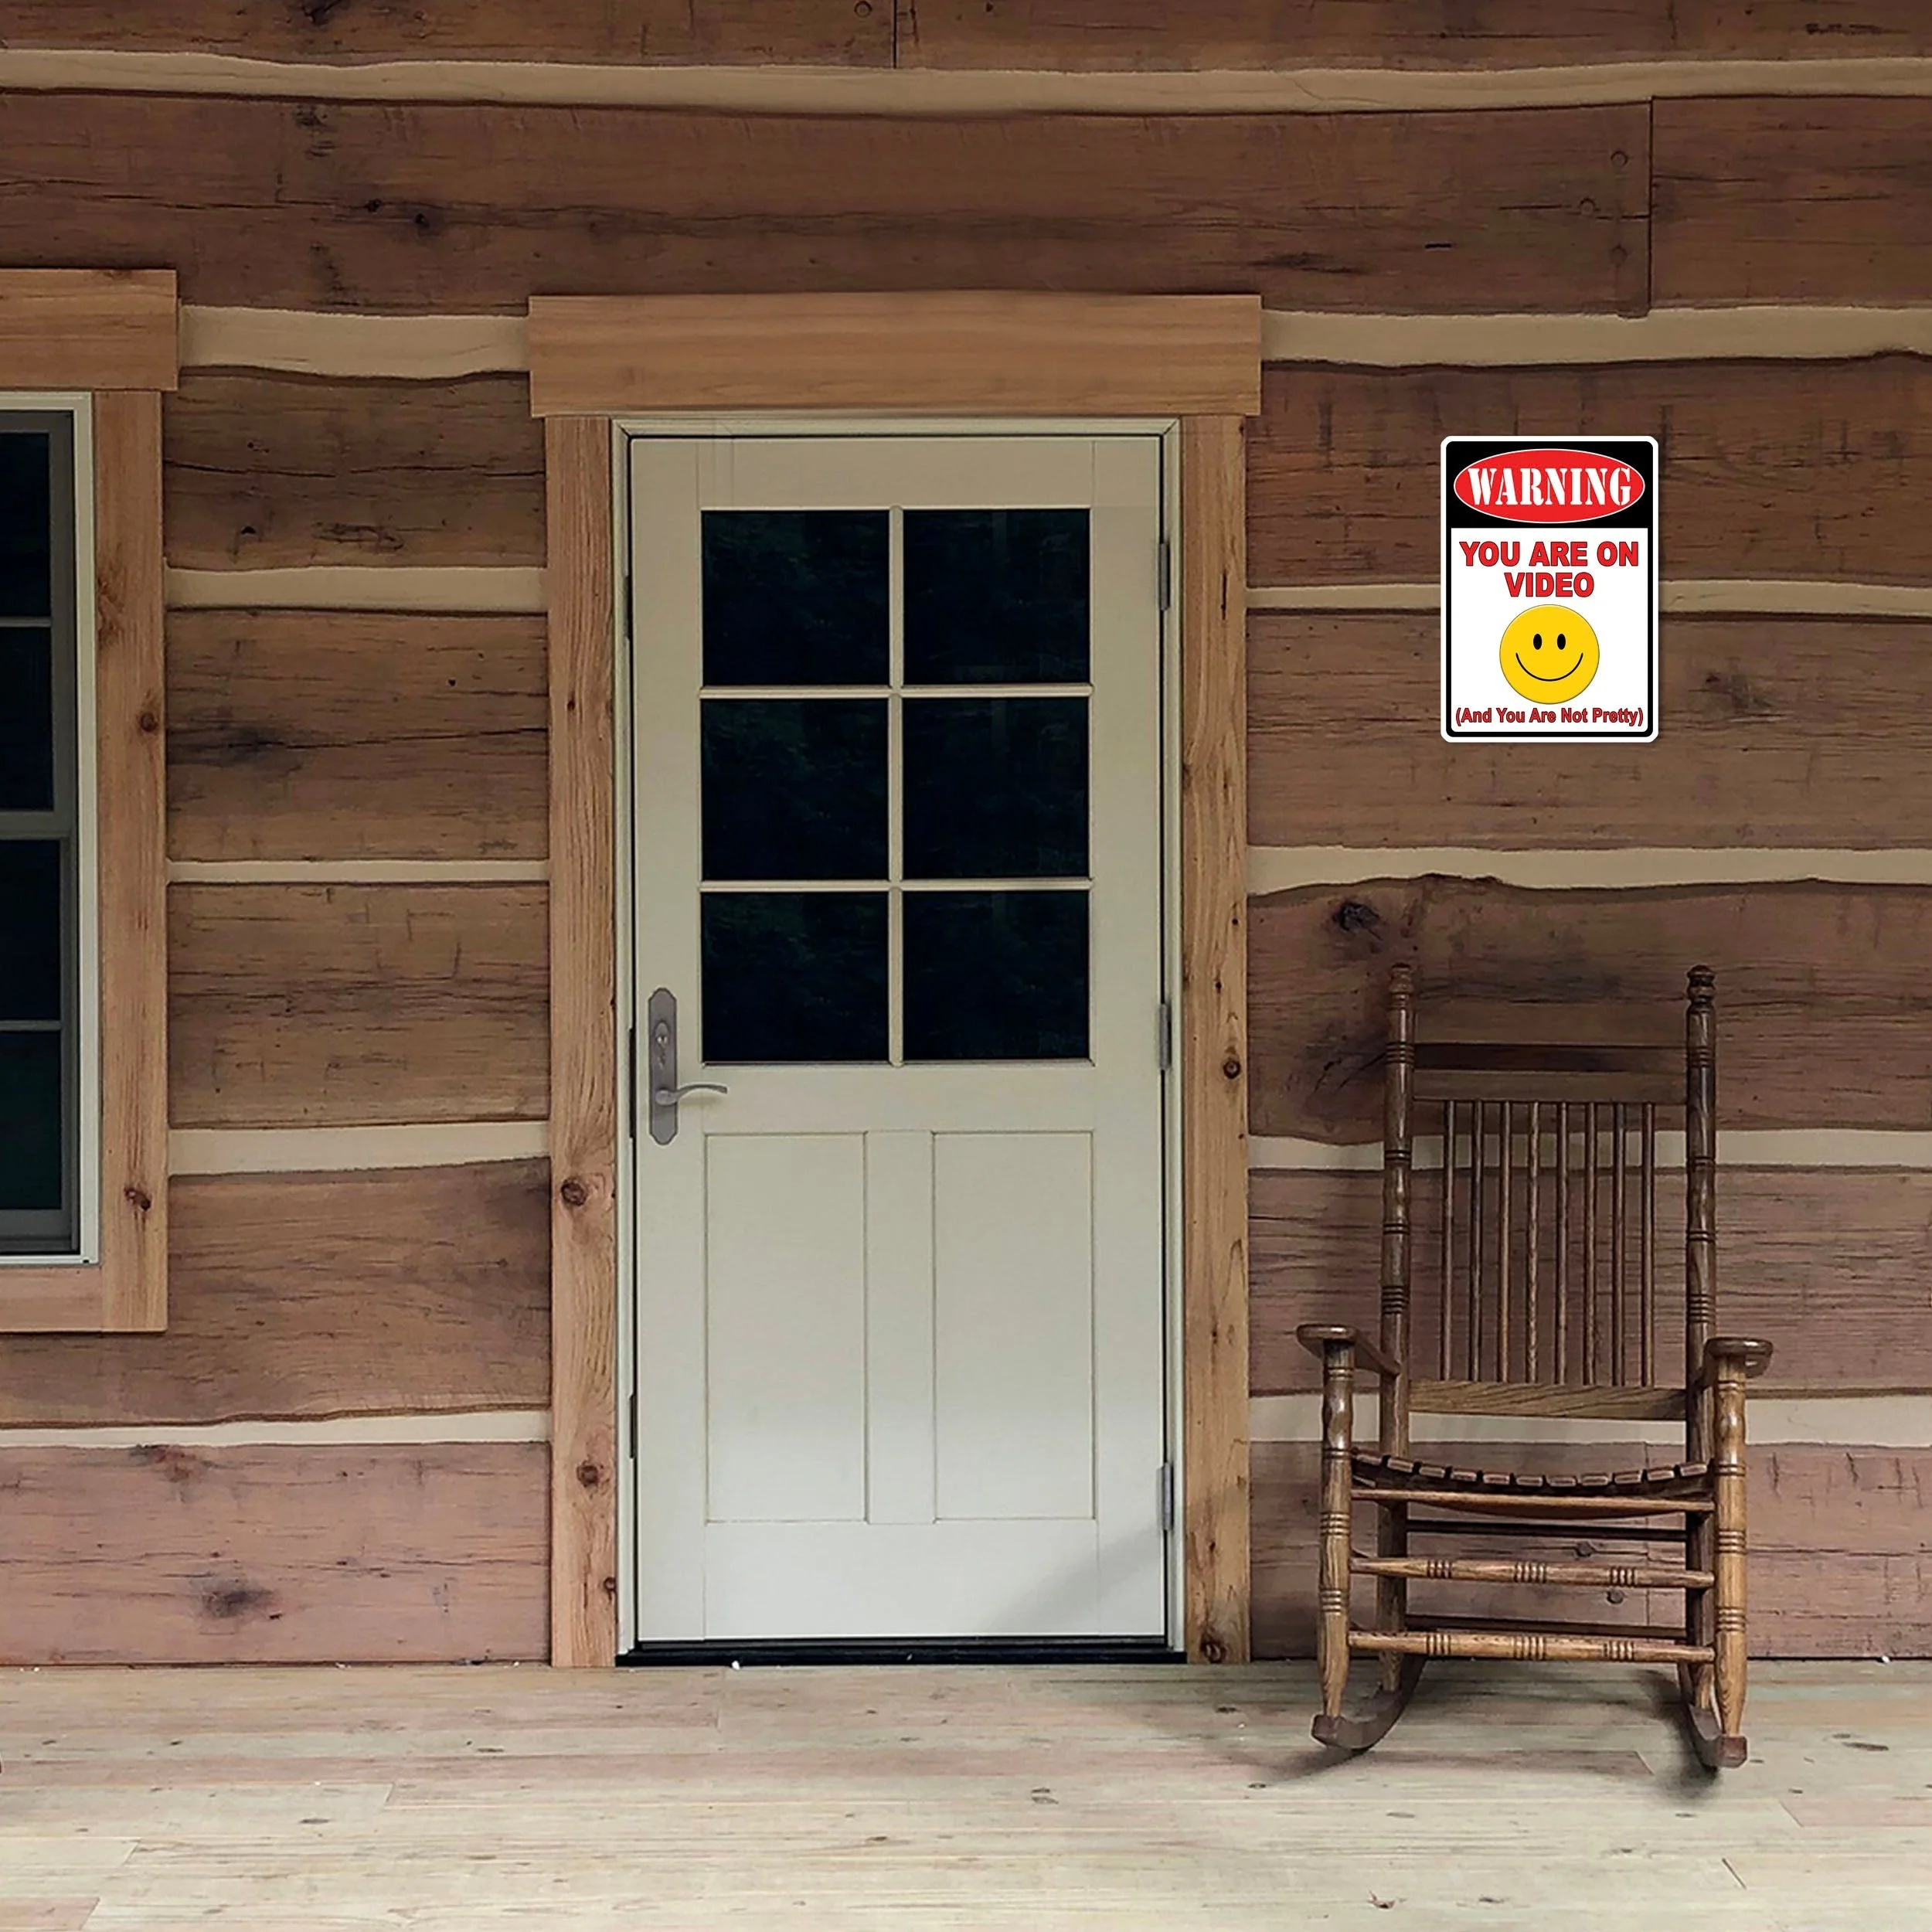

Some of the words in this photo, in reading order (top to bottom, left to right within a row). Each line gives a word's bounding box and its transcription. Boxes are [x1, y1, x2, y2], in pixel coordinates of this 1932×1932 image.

[1468, 468, 1632, 506] WARNING
[1459, 541, 1521, 567] YOU
[1529, 541, 1588, 567] ARE
[1597, 541, 1639, 567] ON
[1504, 572, 1594, 597] VIDEO
[1455, 707, 1492, 726] (And
[1496, 708, 1526, 723] You
[1529, 708, 1556, 723] Are
[1561, 708, 1588, 723] Not
[1593, 707, 1644, 726] Pretty)
